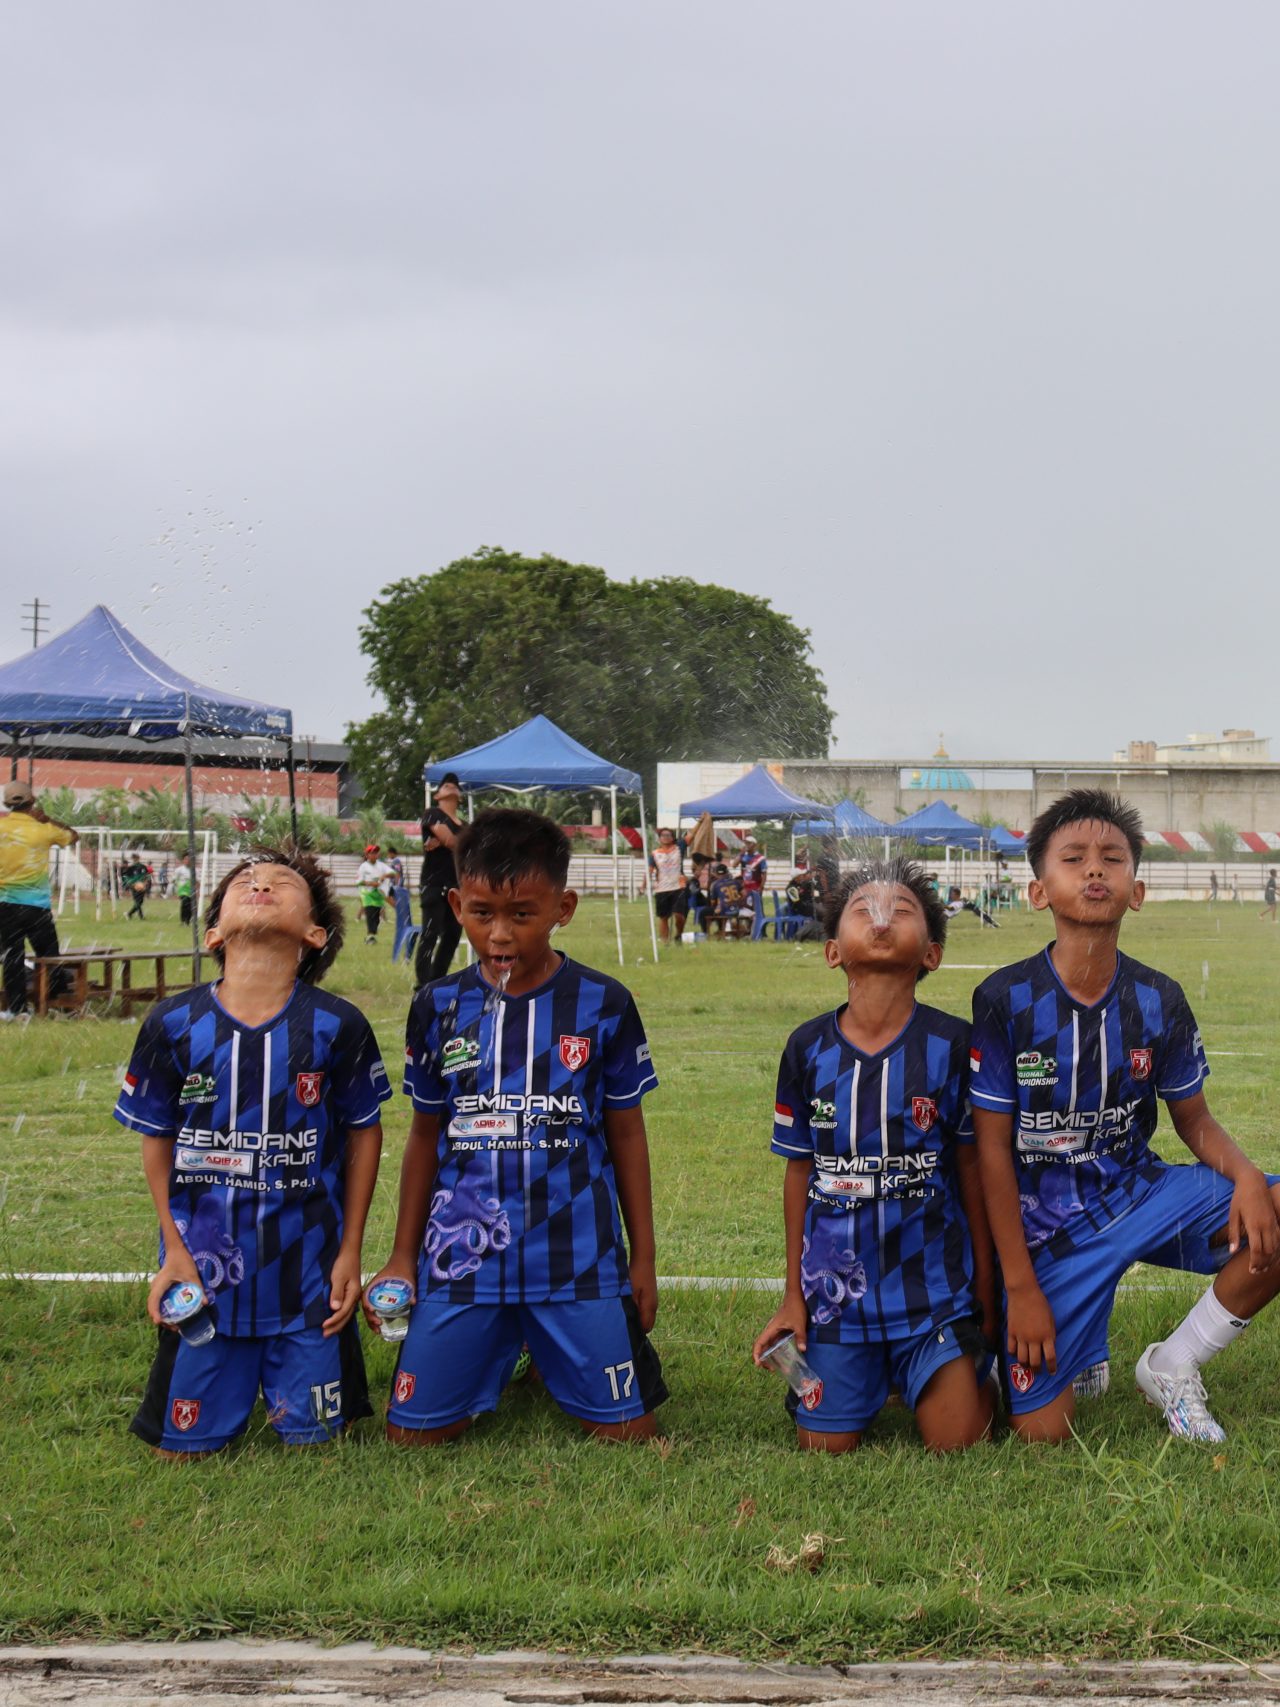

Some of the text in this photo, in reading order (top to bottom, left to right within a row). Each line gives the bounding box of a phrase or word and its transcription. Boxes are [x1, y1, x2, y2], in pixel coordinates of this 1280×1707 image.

[1017, 1056, 1039, 1065] MILO
[1017, 1071, 1045, 1079] GIONAL
[1017, 1077, 1060, 1087] MPIONSHIP
[453, 1094, 583, 1113] SEMIDANG
[523, 1113, 583, 1128] KAUR
[177, 1126, 318, 1152] SEMIDANG
[487, 1139, 535, 1151] HAMID,
[539, 1139, 551, 1149] S.
[555, 1138, 572, 1149] Pd.
[258, 1150, 316, 1169] KAUR
[813, 1151, 938, 1173] SEMIDANG
[175, 1174, 222, 1185] ABDUL
[225, 1177, 271, 1193] HAMID,
[275, 1179, 287, 1190] S.
[881, 1168, 933, 1189] KAUR
[909, 1188, 927, 1199] Pd.
[604, 1360, 635, 1400] 17
[311, 1381, 341, 1420] 15
